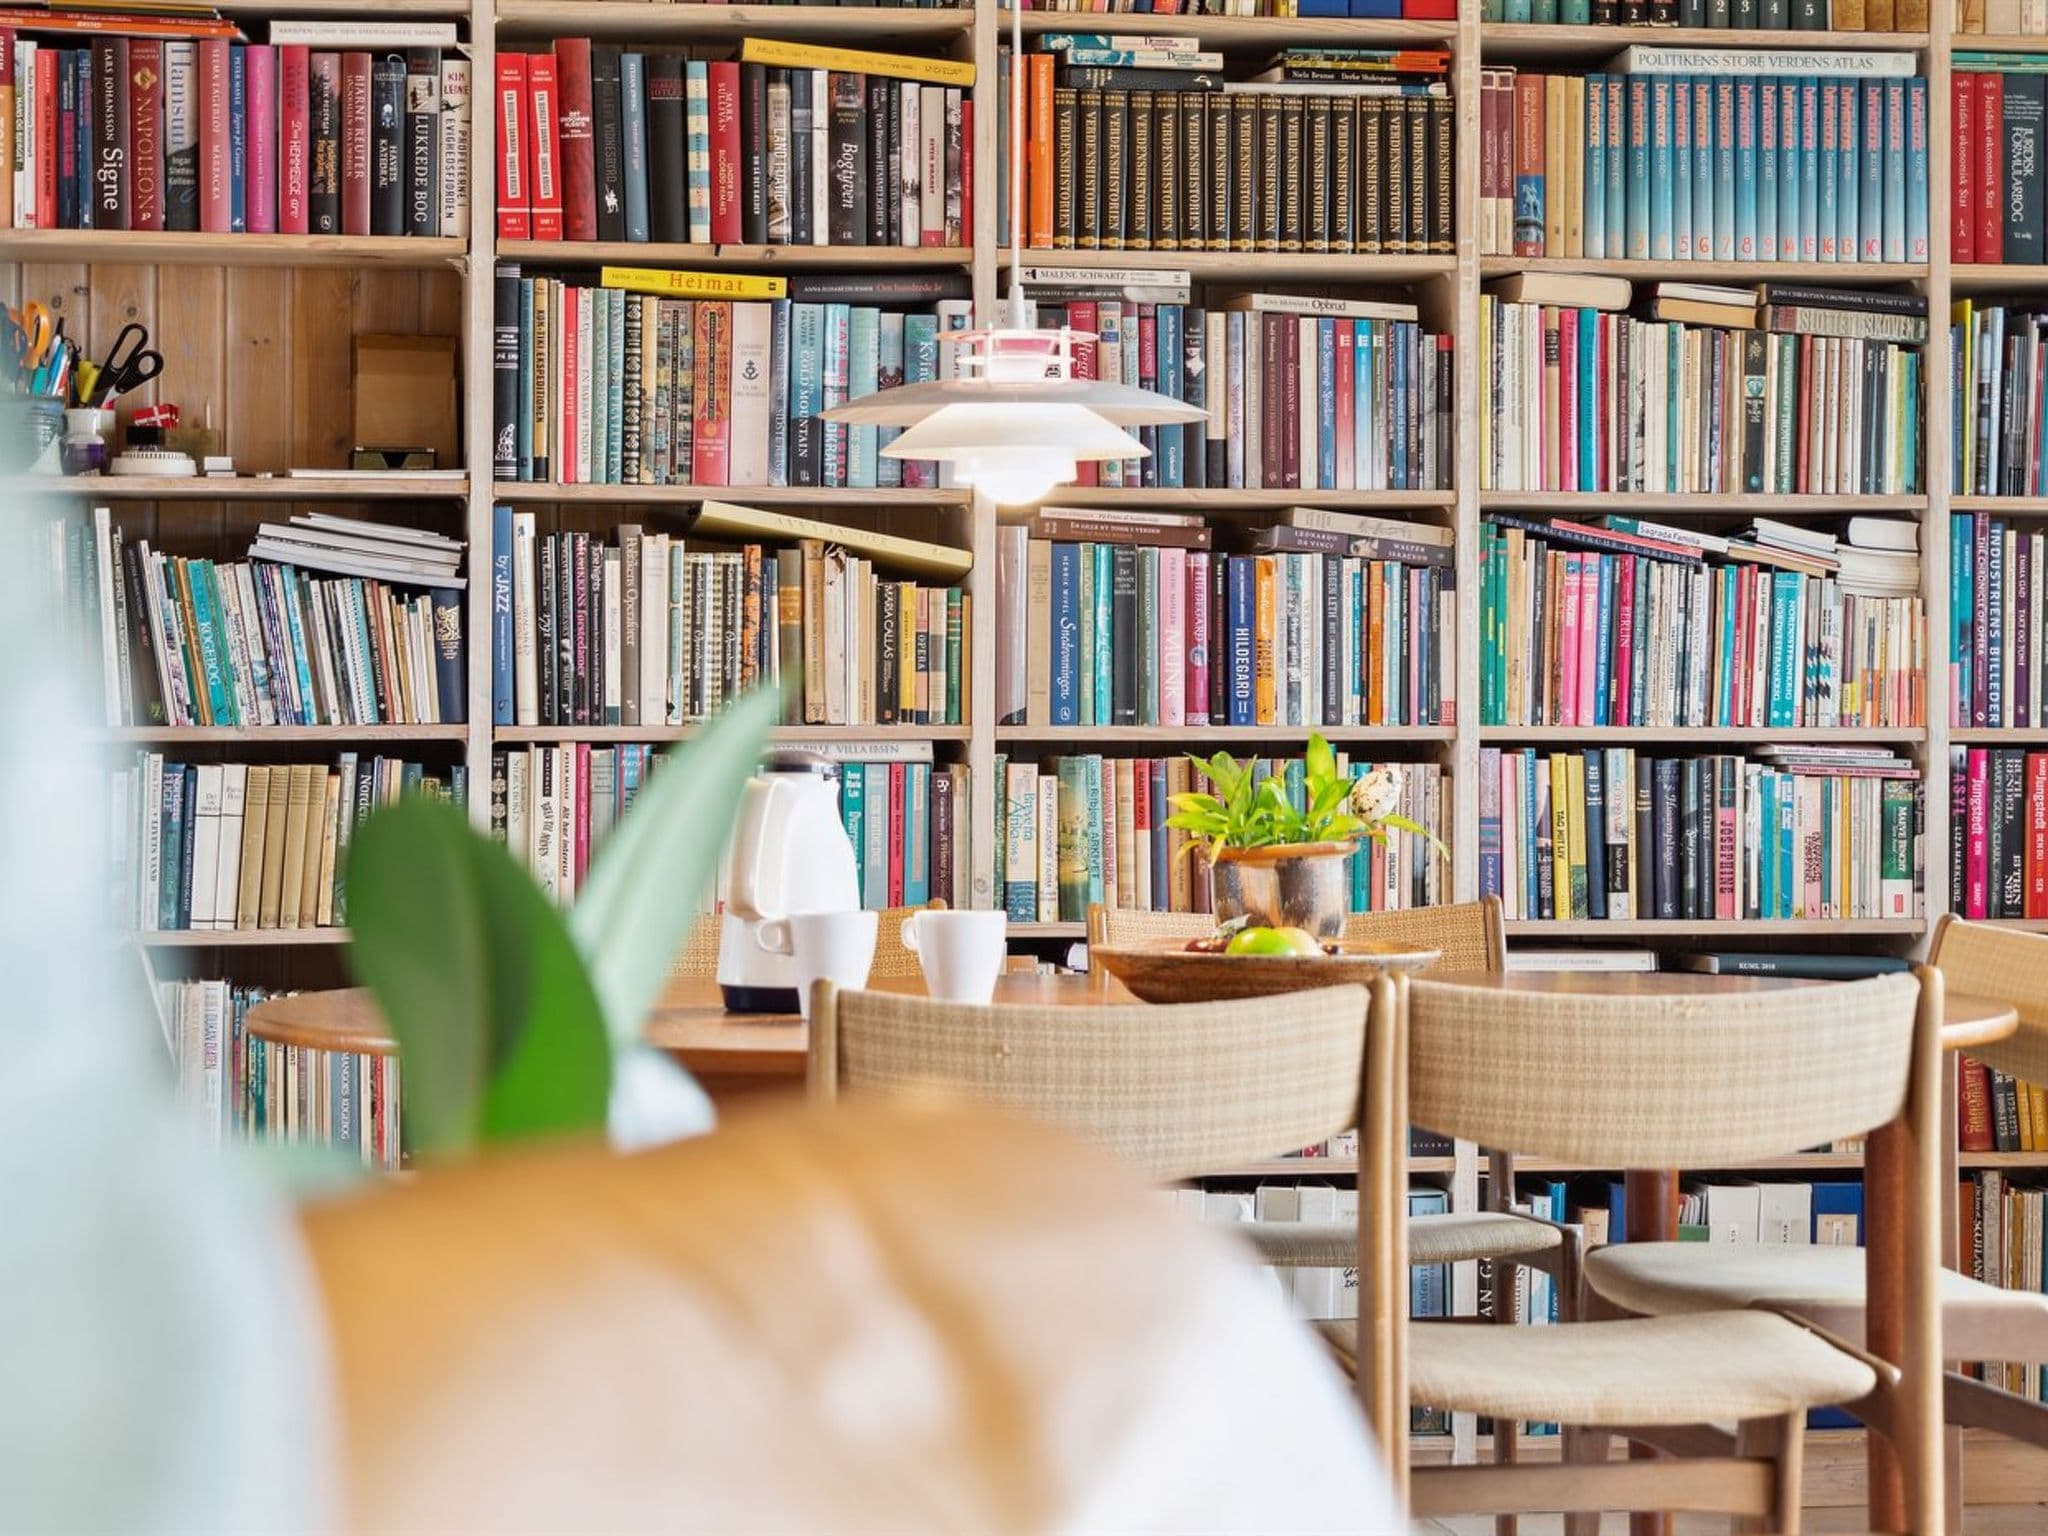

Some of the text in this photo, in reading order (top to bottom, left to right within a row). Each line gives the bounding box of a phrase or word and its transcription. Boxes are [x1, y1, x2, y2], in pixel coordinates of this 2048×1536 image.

[104, 49, 114, 141] LARS JOHANSSON
[171, 49, 192, 146] Hamsun
[1638, 53, 1874, 69] POLITIKENS STORE VERDENS ATLAS
[137, 98, 154, 209] NAPOLEON
[355, 75, 366, 179] BJARNE REUTER
[379, 138, 389, 188] KATEDRAL
[415, 115, 428, 186] LUKKEDE
[445, 118, 456, 219] EVIGHEDSFJORDEN
[1060, 111, 1071, 229] VERDENSHISTORIEN
[1084, 111, 1096, 229] VERDENSHISTORIEN
[1109, 113, 1121, 231] VERDENSHISTORIEN
[1135, 114, 1147, 232] VERDENSHISTORIEN
[1162, 114, 1173, 232] VERDENSHISTORIEN
[1189, 114, 1200, 231] VERDENSHISTORIEN
[1215, 114, 1226, 232] VERDENSHISTORIEN
[1240, 114, 1251, 232] VERDENSHISTORIEN
[1265, 115, 1276, 232] VERDENSHISTORIEN
[1959, 94, 1968, 208] Juridisk-økonomisk Stat
[1984, 95, 1994, 209] Juridisk-økonomisk Stat
[2022, 127, 2034, 177] JURIDISK
[97, 148, 123, 210] Signe
[414, 190, 428, 222] BOG
[836, 143, 858, 208] Bogtyven
[1287, 116, 1298, 233] VERDENSHISTORIEN
[1313, 116, 1325, 233] VERDENSHISTORIEN
[1338, 116, 1348, 233] VERDENSHISTORIEN
[1367, 117, 1378, 233] VERDENSHISTORIEN
[1390, 116, 1400, 233] VERDENSHISTORIEN
[1413, 117, 1423, 234] VERDENSHISTORIEN
[1439, 118, 1450, 234] VERDENSHISTORIEN
[2011, 127, 2023, 222] FORMULARBOG
[669, 273, 745, 293] Heimat
[535, 309, 545, 423] KON-TIKI EKSPEDITIONEN
[798, 350, 808, 458] COLD MOUNTAIN
[496, 555, 510, 613] by JAZZ
[883, 584, 893, 659] MARIA CALLAS
[1328, 596, 1337, 618] LETH
[1989, 529, 2000, 723] INDUSTRIENS BILLEDER
[201, 621, 220, 685] KOGEBOG
[917, 634, 926, 670] OPERA
[1165, 630, 1181, 699] MUNK
[1236, 628, 1249, 698] HILDEGARD
[1977, 626, 1985, 655] OPERA
[1953, 773, 1966, 817] ASYL
[1970, 778, 1983, 835] Jungstedt
[2005, 759, 2014, 824] RENDELL
[2014, 759, 2022, 798] RUTH
[2033, 776, 2047, 829] Jungstedt
[1090, 832, 1100, 879] ARKIVET
[1719, 820, 1734, 894] JOSEPHINE
[1953, 851, 1961, 902] MARKLUND
[2004, 875, 2012, 905] NED
